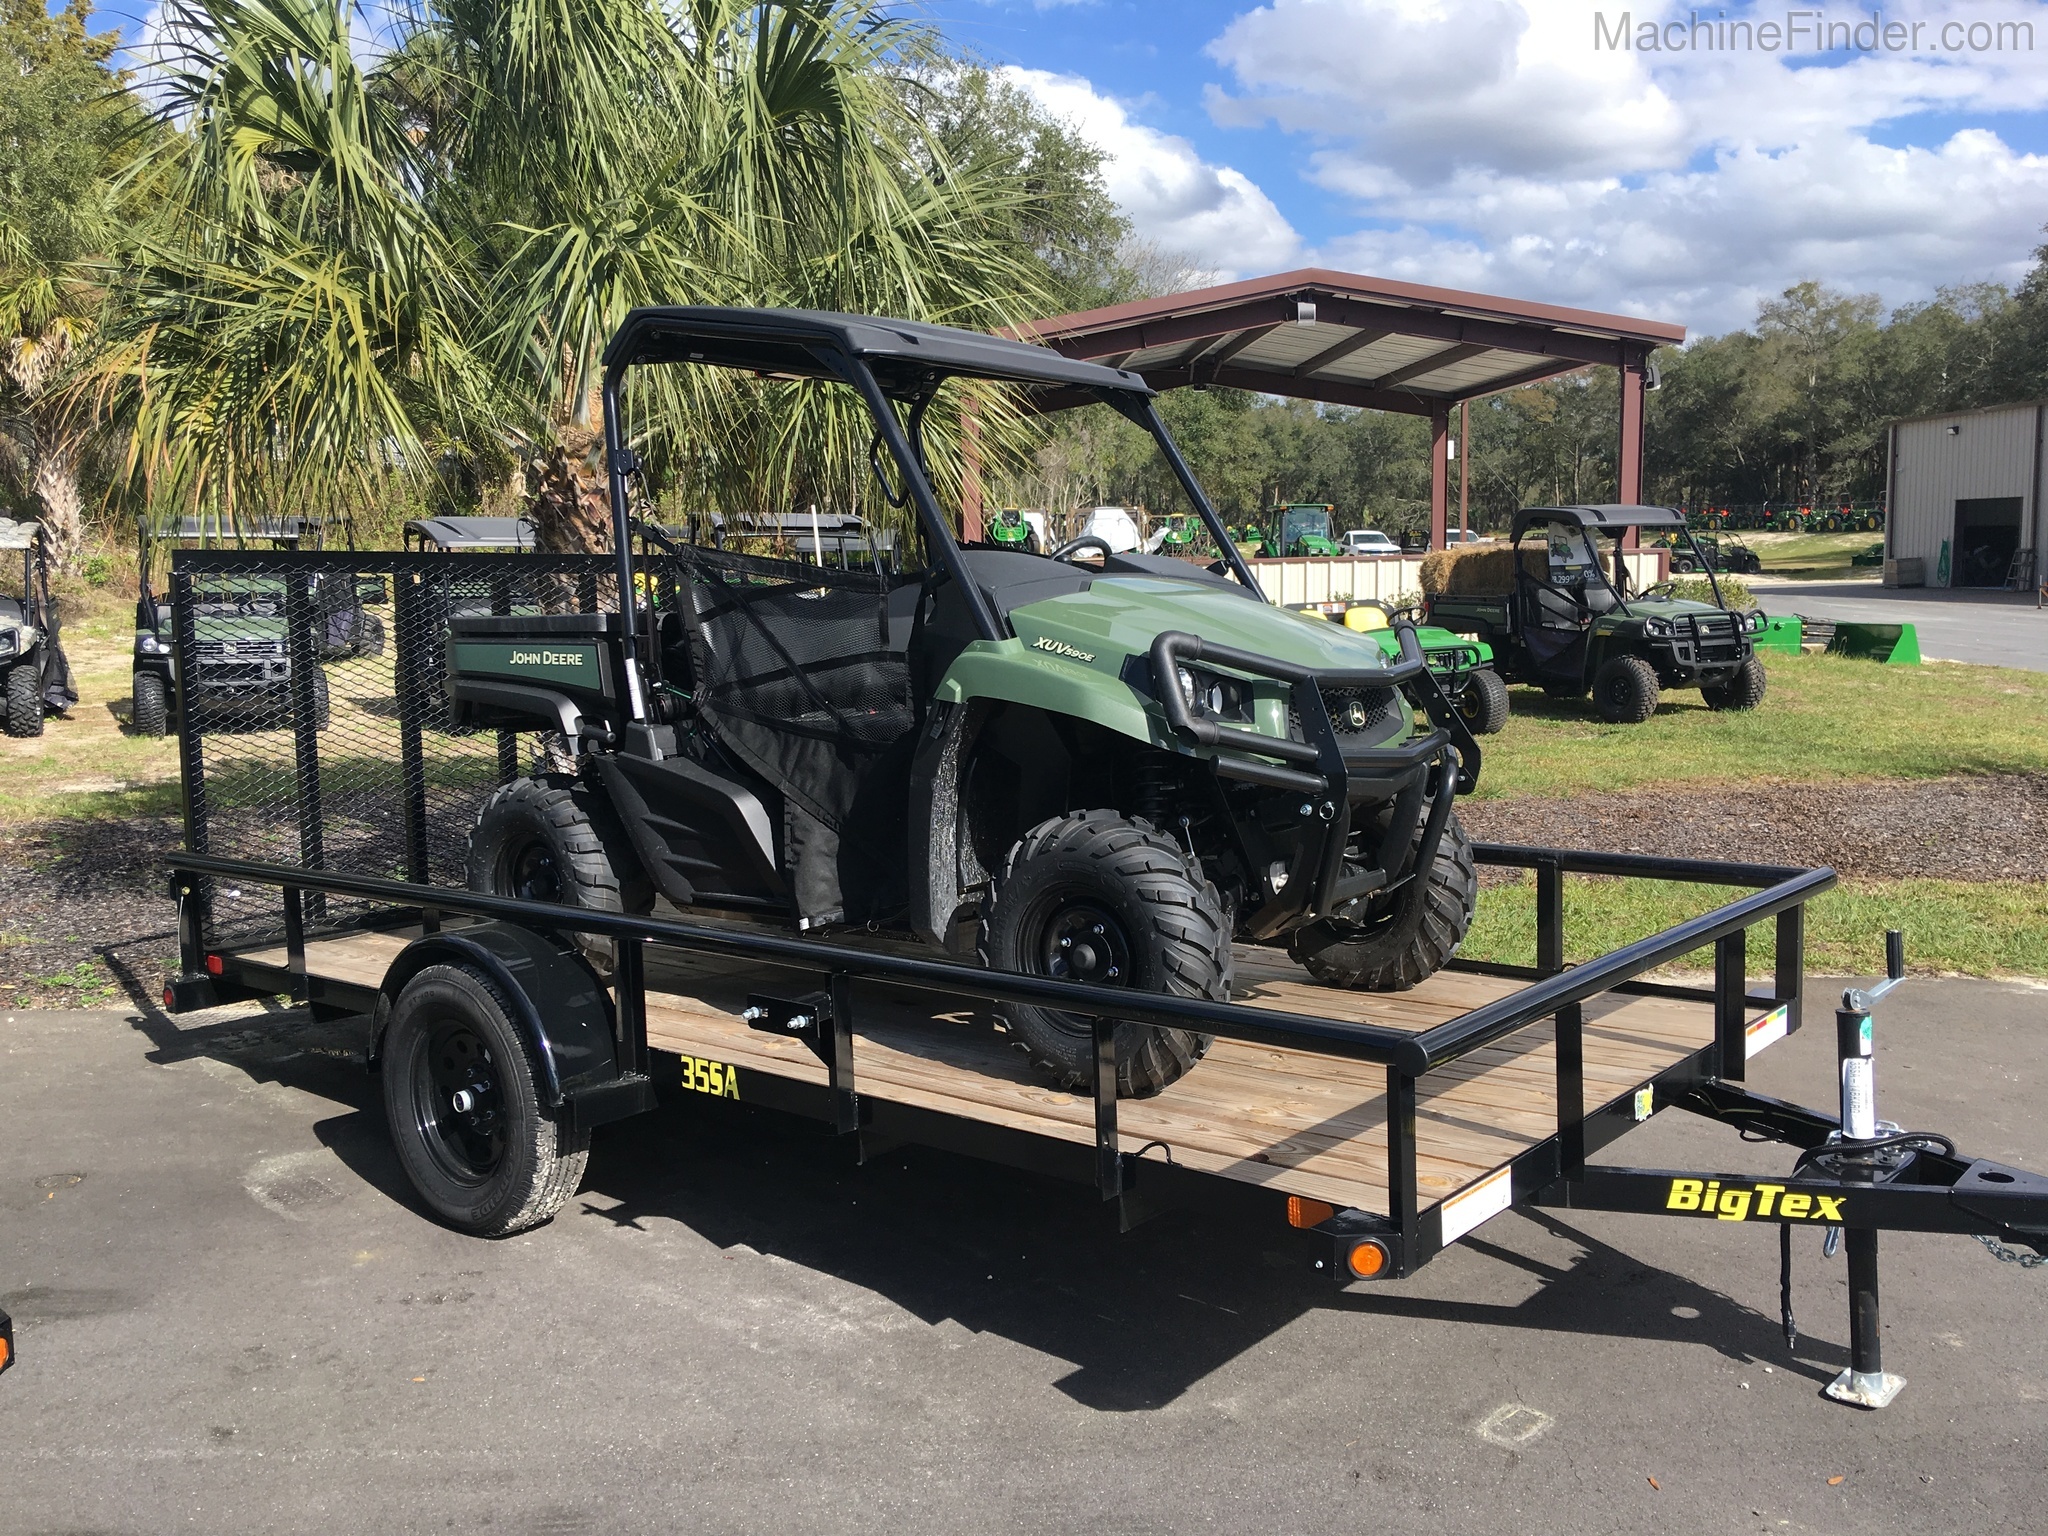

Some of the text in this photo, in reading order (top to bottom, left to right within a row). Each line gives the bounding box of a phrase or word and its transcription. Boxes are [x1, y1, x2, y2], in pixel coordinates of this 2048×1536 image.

[509, 650, 583, 666] JOHN DEERE
[1031, 636, 1096, 662] XUV590E
[680, 1055, 741, 1101] 35SA
[1666, 1179, 1847, 1221] BigTex
